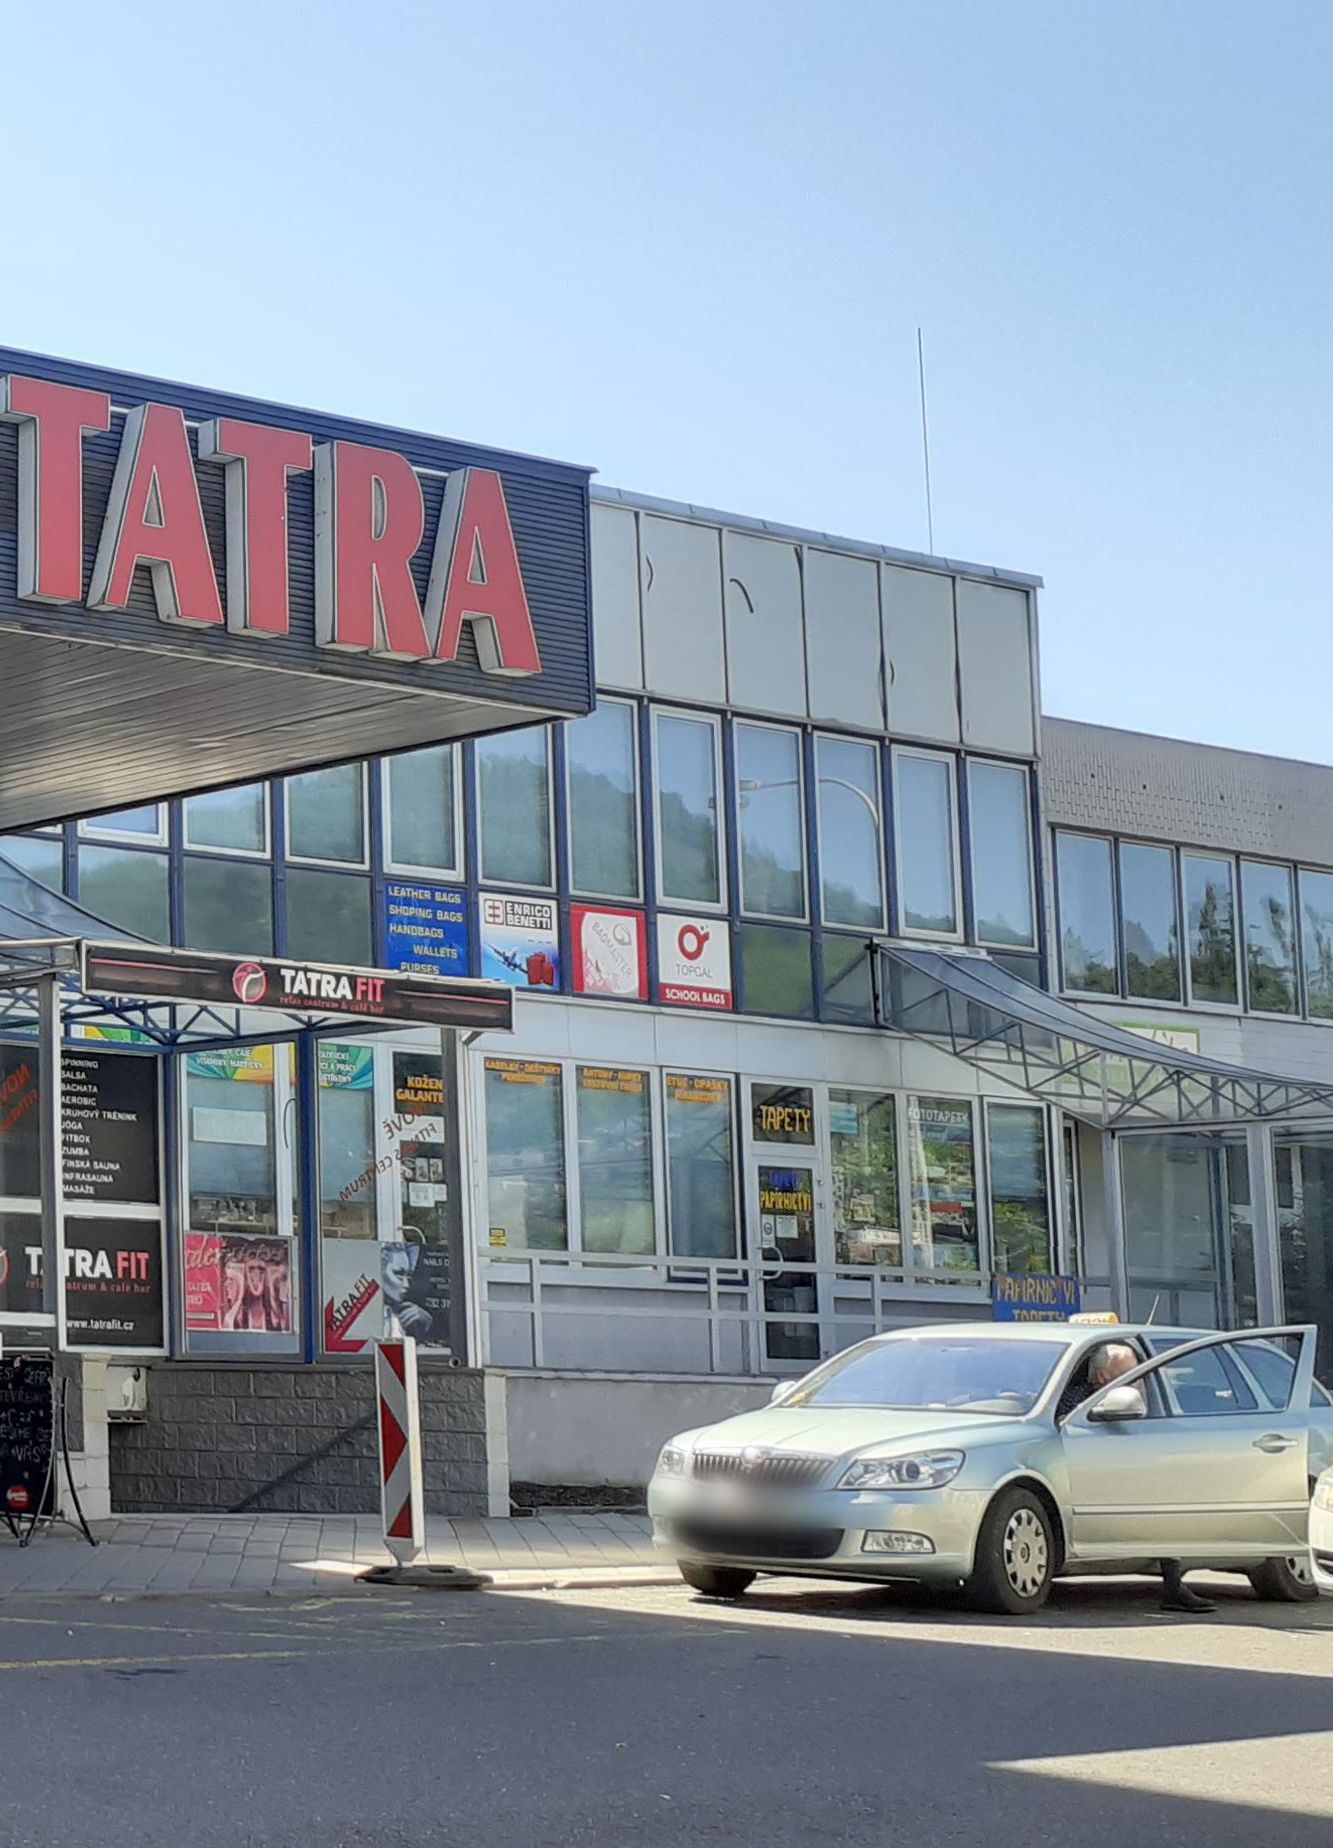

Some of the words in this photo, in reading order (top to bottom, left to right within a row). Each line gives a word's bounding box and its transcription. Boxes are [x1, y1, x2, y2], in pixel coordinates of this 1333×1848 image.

[388, 886, 431, 899] LEATHER
[435, 891, 461, 904] BAGS
[389, 904, 433, 919] SHOPING
[436, 910, 463, 922] BAGS
[507, 902, 551, 918] ENRICO
[507, 914, 552, 930] BENETTI
[389, 923, 444, 938] HANDBAGS
[413, 944, 458, 959] WALLETS
[591, 921, 633, 979] BAGMASTER
[400, 962, 440, 975] PURSES
[676, 964, 713, 979] TOPGAL
[280, 968, 353, 1000] TATRA
[356, 977, 385, 1002] FIT
[665, 988, 700, 1003] SCHOOL
[701, 991, 726, 1005] BAGS
[61, 1070, 86, 1080] SALSA
[61, 1095, 97, 1106] AEROBIC
[759, 1104, 811, 1133] TAPETY
[908, 1107, 969, 1124] FOTOTAPETY
[62, 1146, 90, 1156] ZUMBA
[93, 1161, 121, 1171] SAUNA
[25, 1246, 113, 1279] TTRA
[116, 1251, 150, 1280] FIT
[66, 1318, 134, 1331] www.tatrafit.cz
